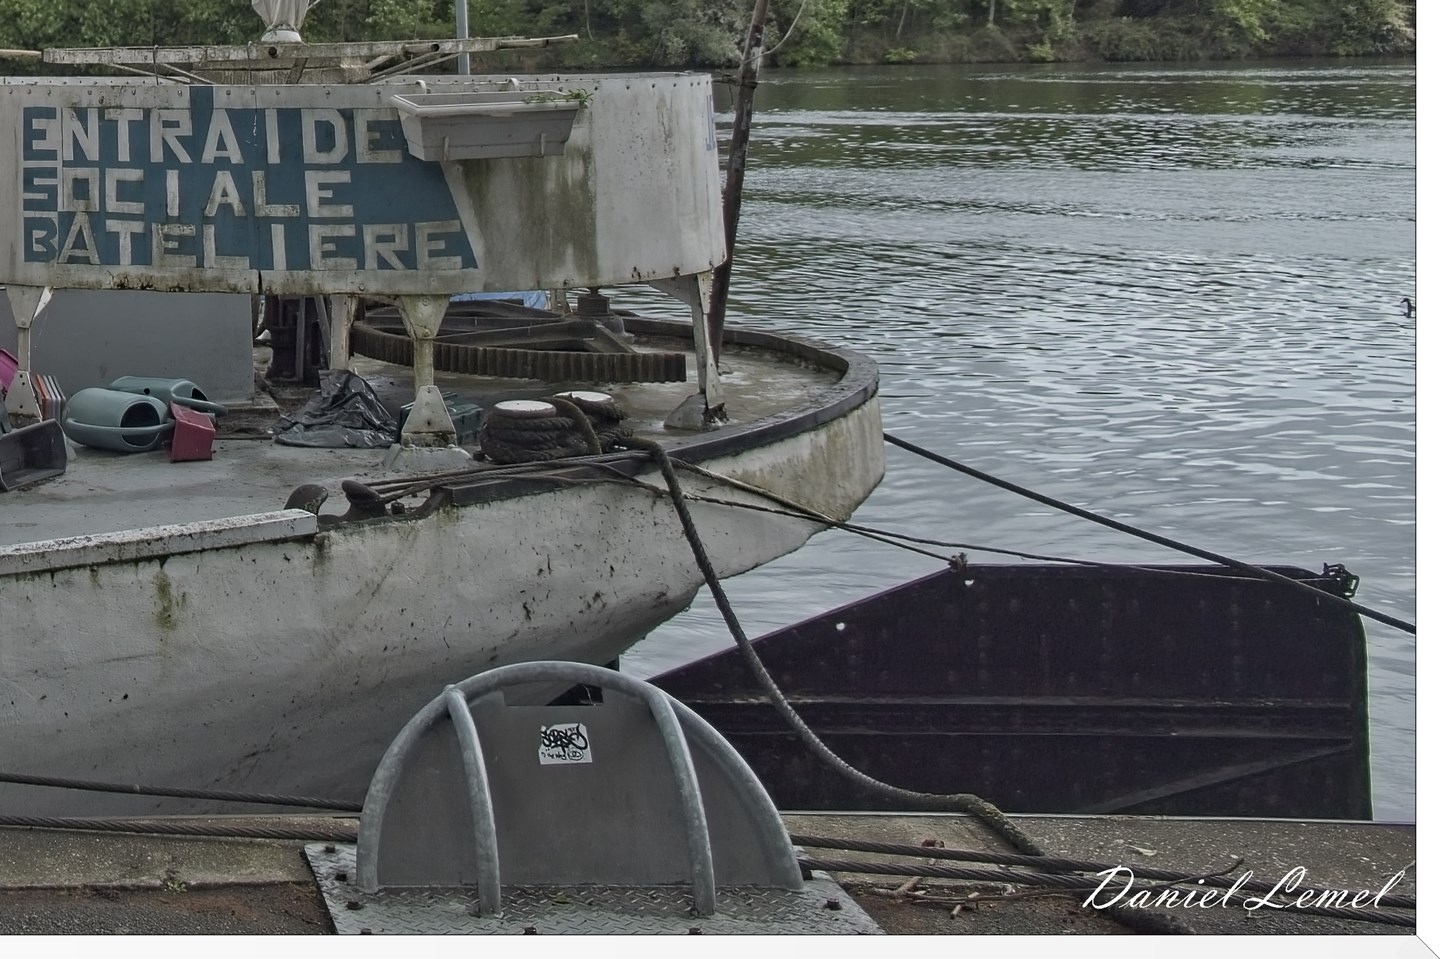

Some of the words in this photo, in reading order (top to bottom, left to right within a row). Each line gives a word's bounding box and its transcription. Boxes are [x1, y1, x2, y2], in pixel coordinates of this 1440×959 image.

[23, 107, 403, 165] ENTRAIDE
[23, 167, 355, 218] SOCIALE
[23, 211, 463, 271] BATELIERE
